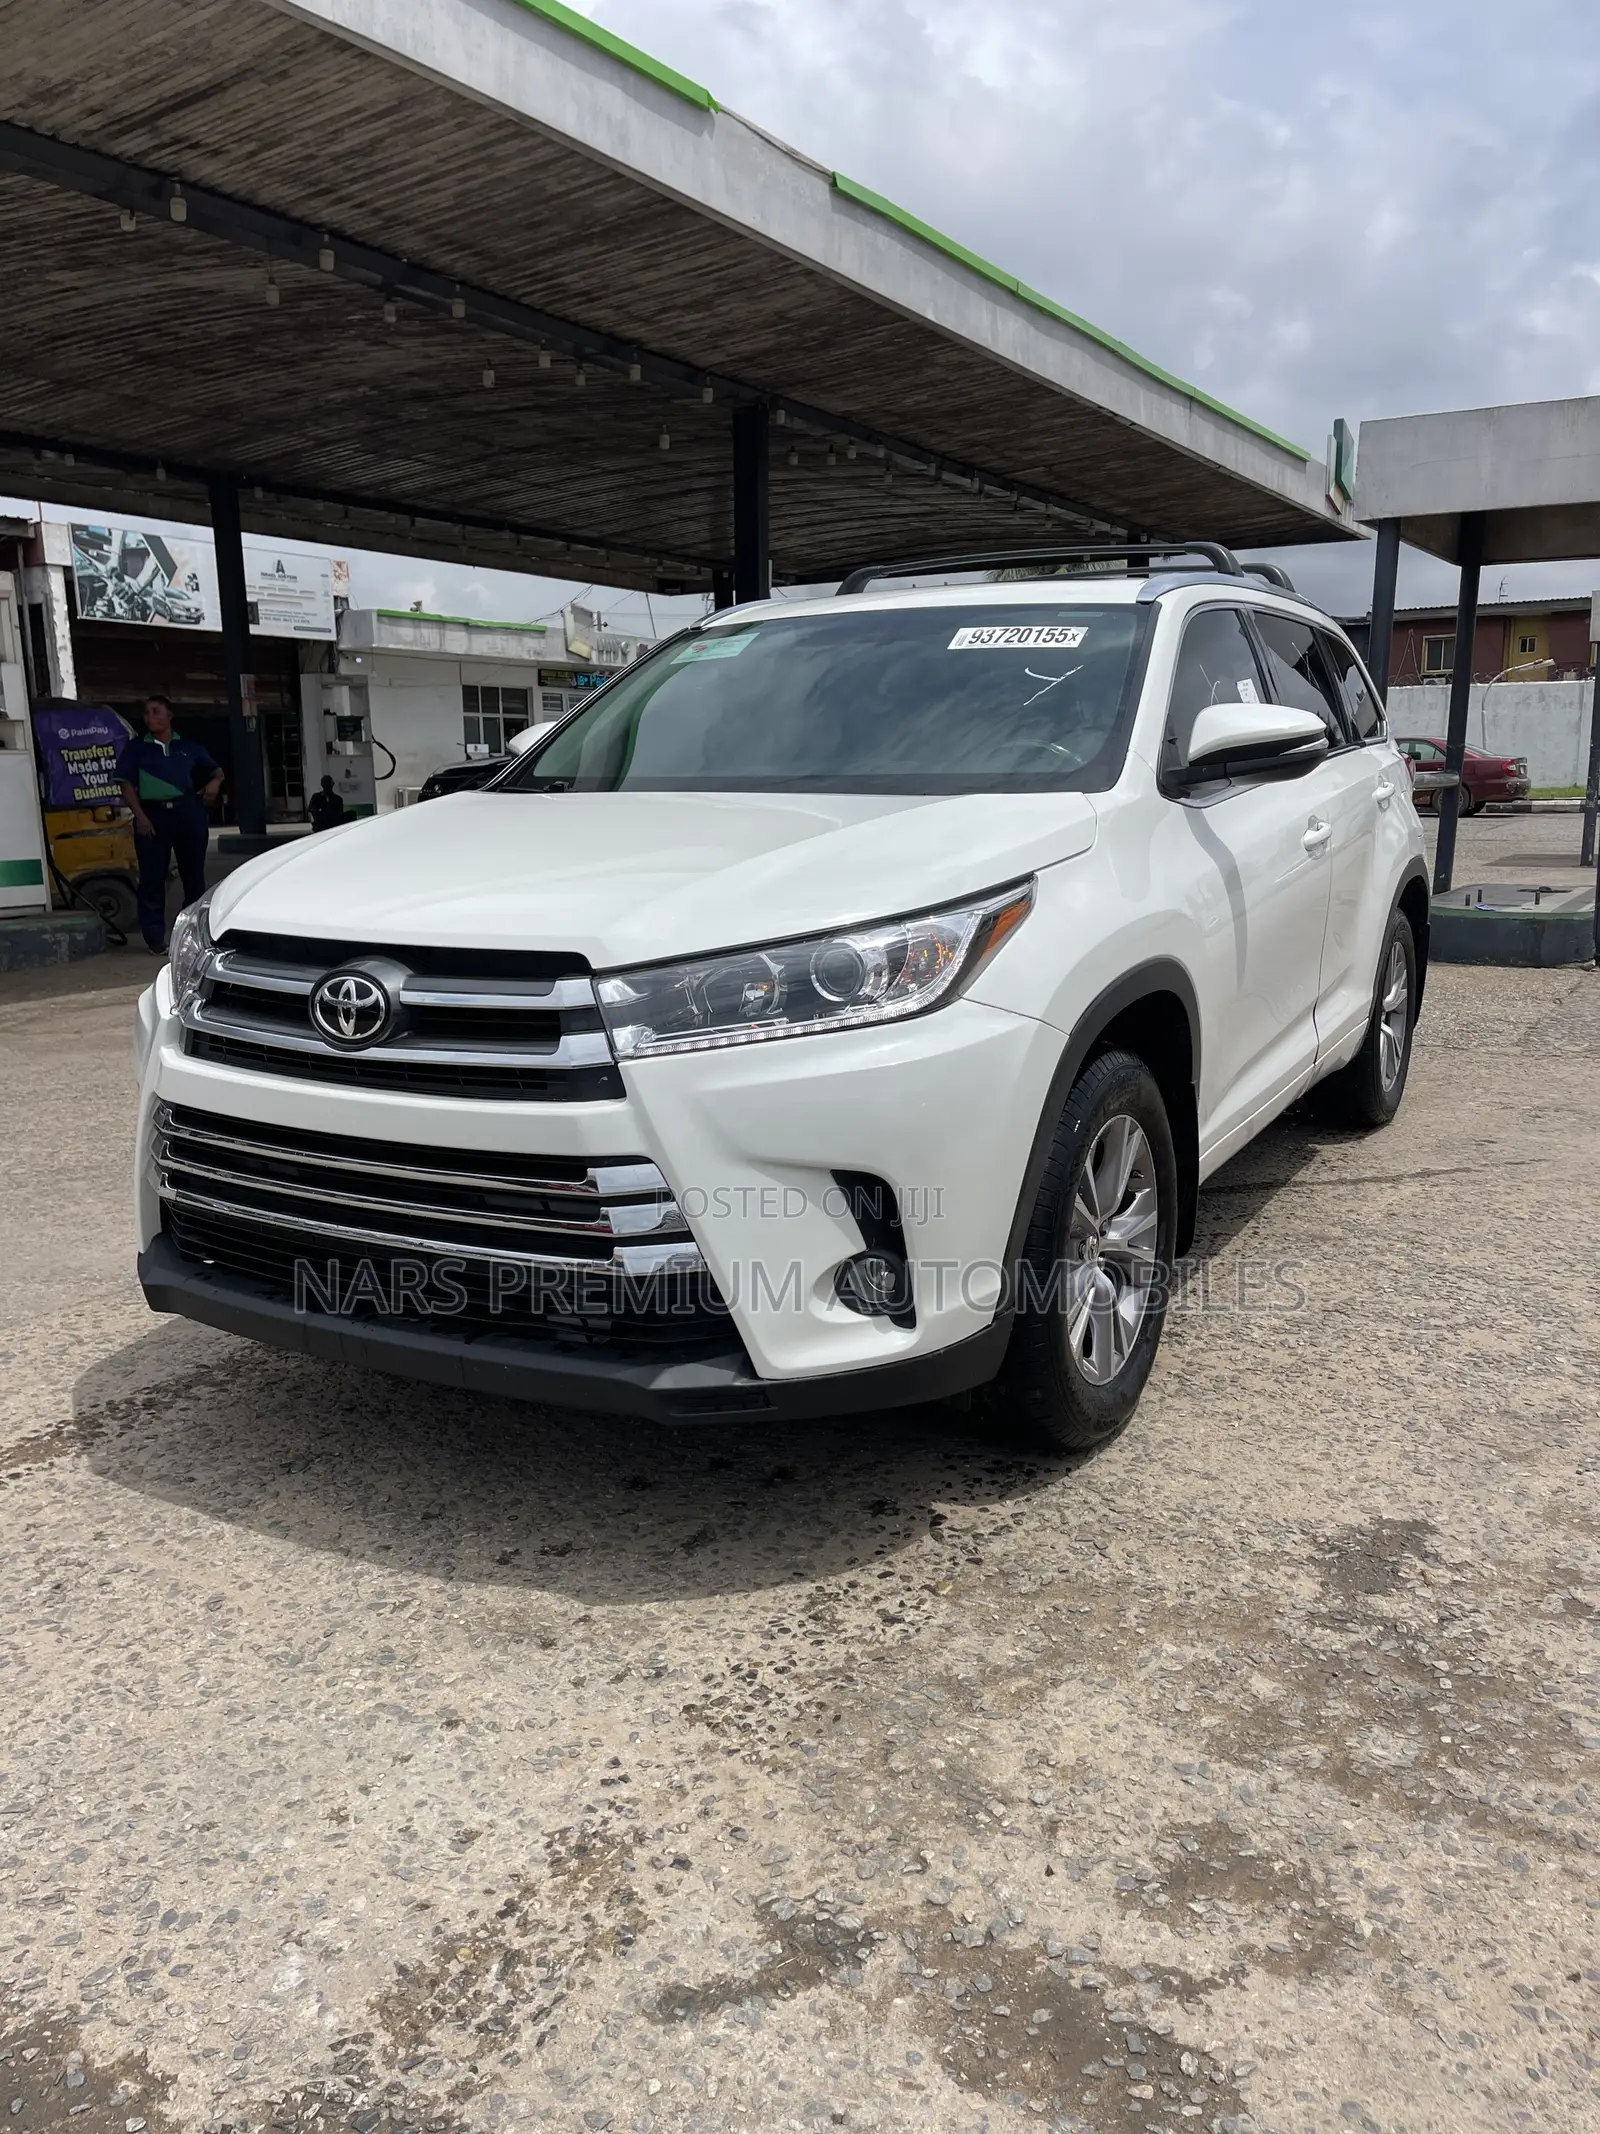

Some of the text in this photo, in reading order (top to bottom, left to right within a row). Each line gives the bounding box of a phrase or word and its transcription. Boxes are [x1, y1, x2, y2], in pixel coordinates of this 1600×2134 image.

[71, 726, 108, 736] PalmPay
[61, 745, 114, 761] Transfers
[67, 757, 117, 775] Made for
[82, 773, 108, 786] Your
